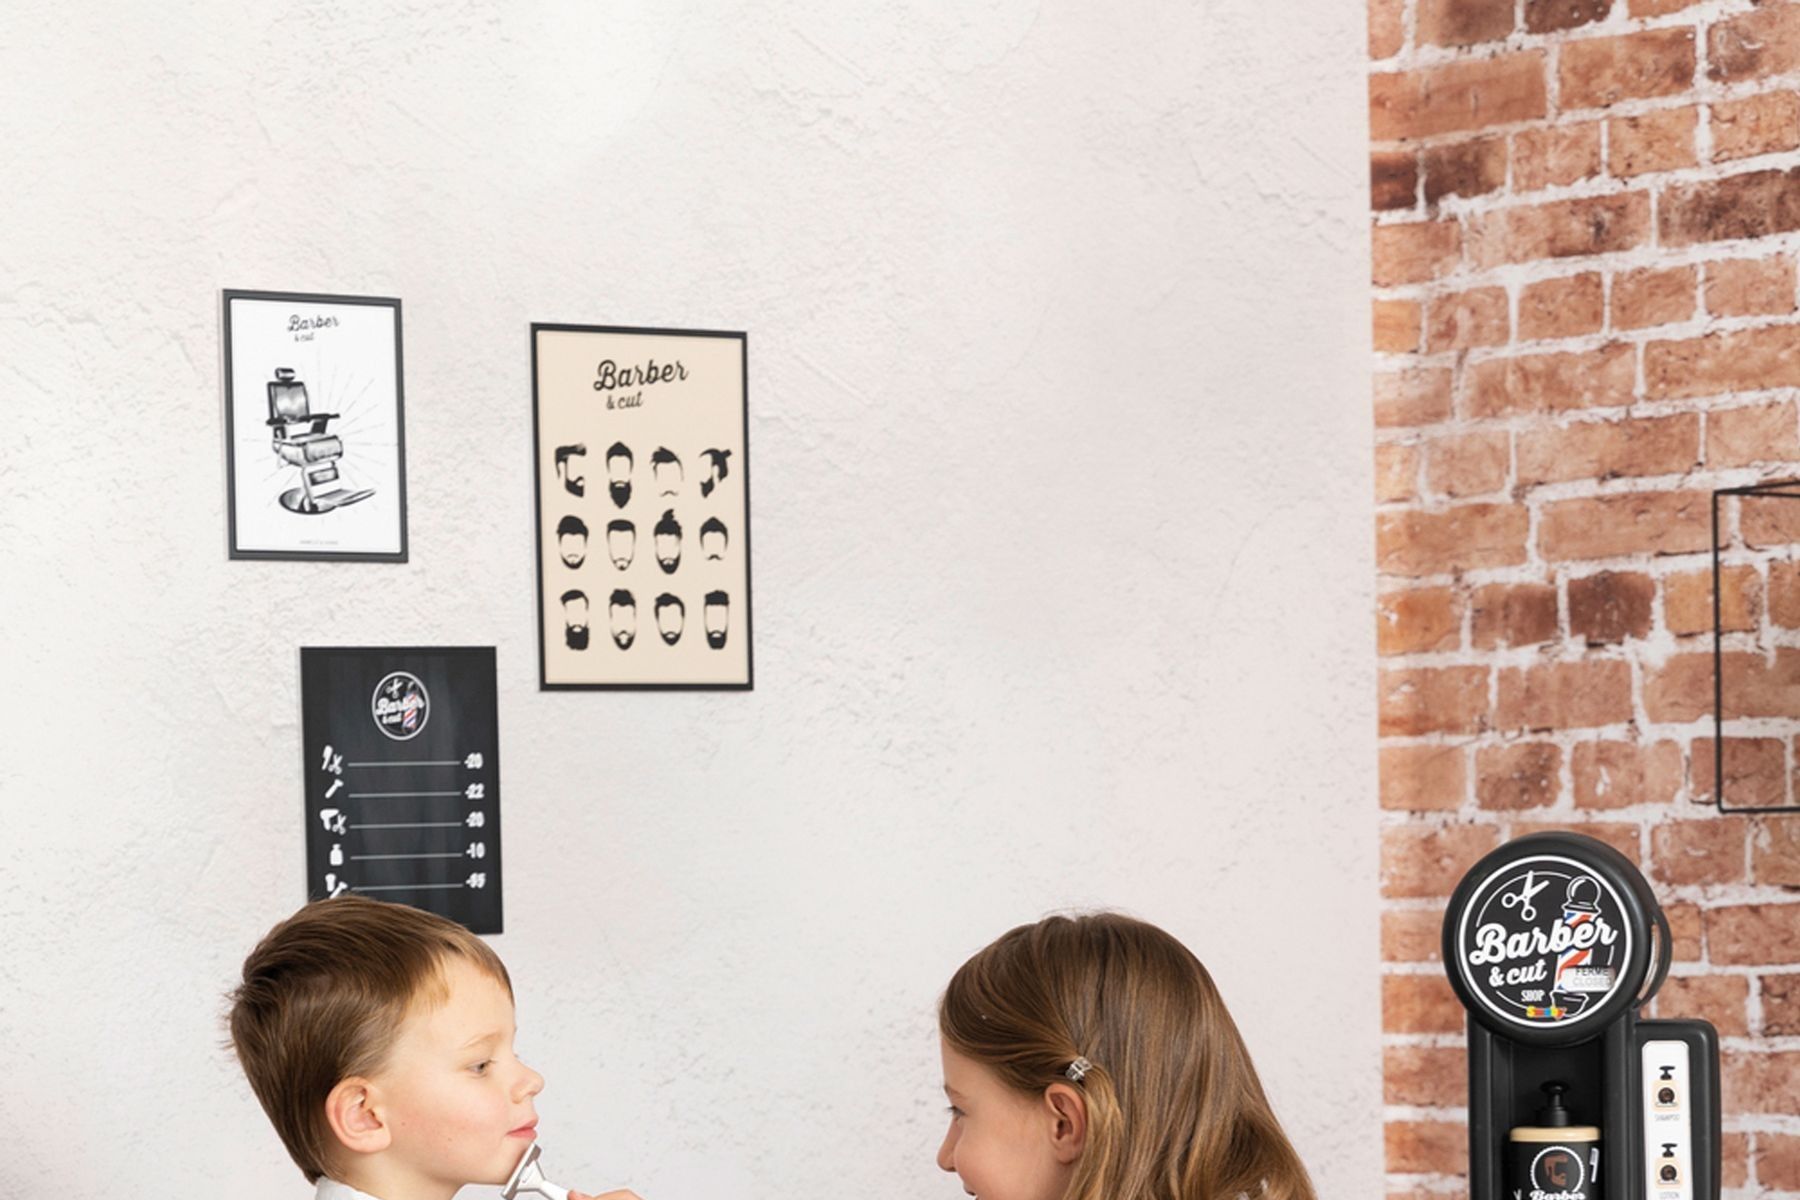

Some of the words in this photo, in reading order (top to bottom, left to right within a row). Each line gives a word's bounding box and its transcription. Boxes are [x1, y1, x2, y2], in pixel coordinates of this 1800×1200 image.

[287, 313, 341, 331] Barber
[593, 359, 689, 391] Barber
[606, 395, 615, 410] &
[617, 391, 644, 409] cut
[1469, 917, 1618, 965] Barber
[1488, 966, 1505, 987] &
[1506, 959, 1548, 985] cut
[1521, 989, 1545, 1002] SHOP
